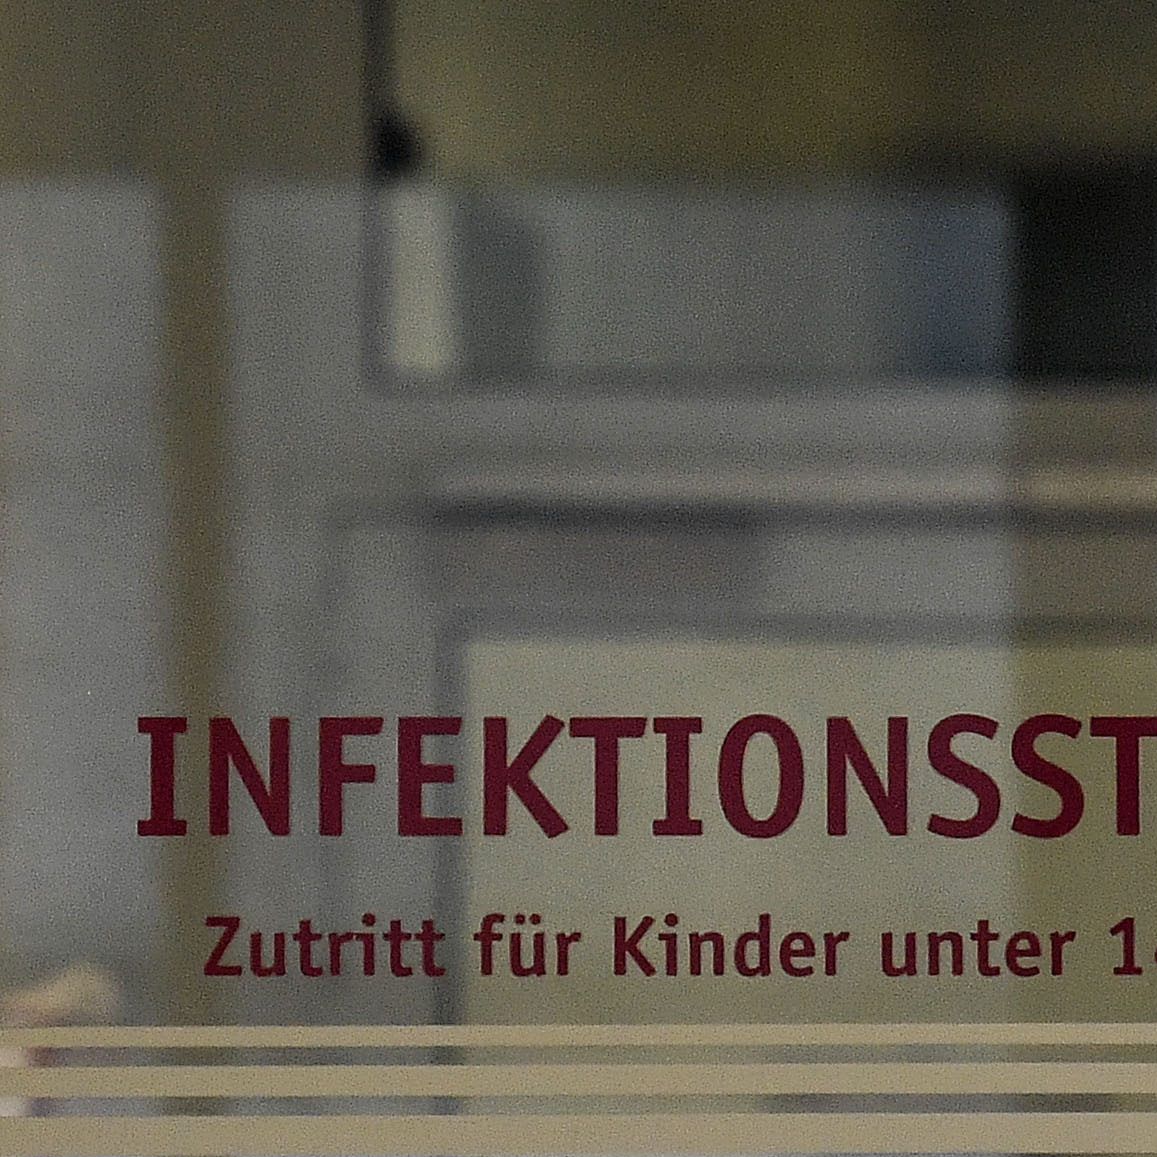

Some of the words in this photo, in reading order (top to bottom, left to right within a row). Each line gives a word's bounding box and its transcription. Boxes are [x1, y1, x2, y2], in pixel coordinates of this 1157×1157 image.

[202, 912, 446, 978] Zutritt
[474, 912, 582, 978] für
[612, 912, 850, 978] Kinder
[880, 918, 1078, 979] unter
